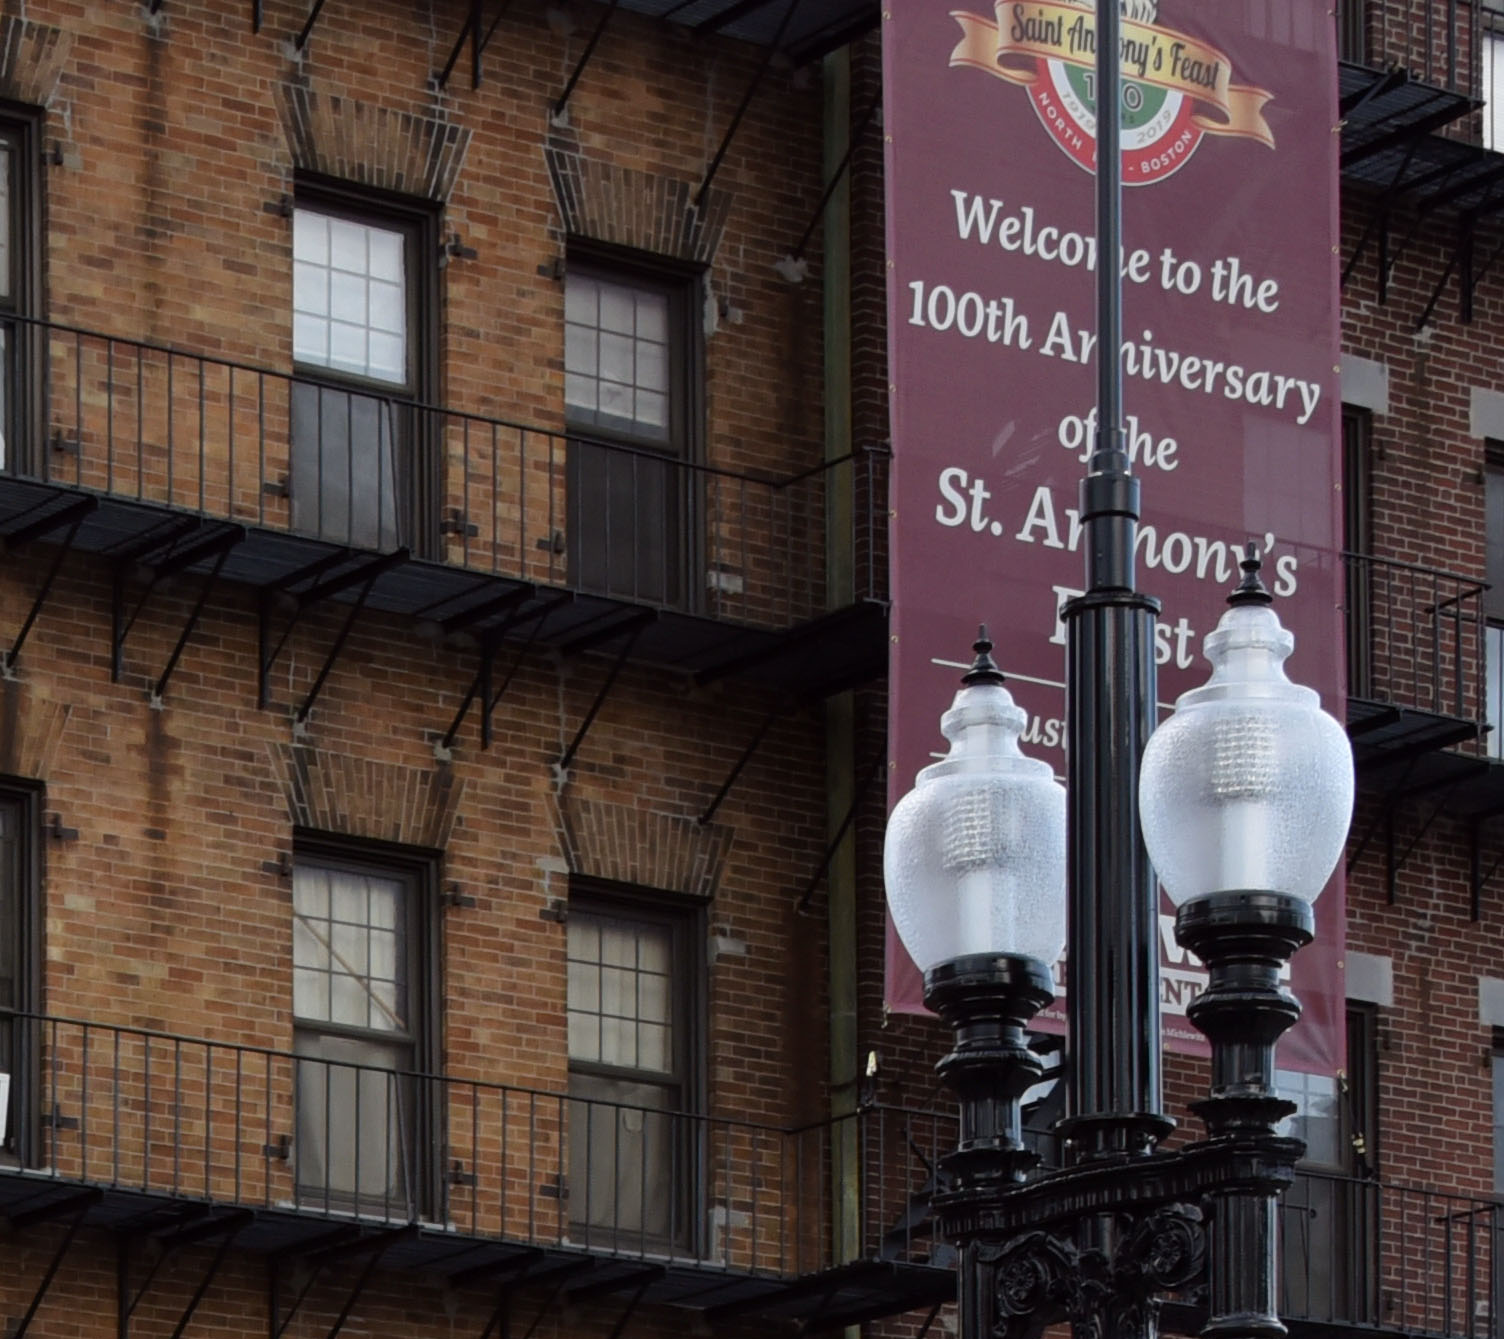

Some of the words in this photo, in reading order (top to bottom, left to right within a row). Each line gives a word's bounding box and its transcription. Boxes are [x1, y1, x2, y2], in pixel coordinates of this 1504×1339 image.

[1011, 4, 1063, 46] Saint
[1068, 19, 1162, 78] Anony's
[1170, 42, 1221, 91] Feast
[1084, 73, 1144, 112] 10
[1137, 108, 1173, 145] 2019
[1039, 91, 1084, 151] NORTH
[1141, 129, 1193, 174] BOSTON
[1161, 246, 1202, 295] to
[1211, 257, 1280, 313] the
[908, 280, 1029, 351] 100th
[1058, 407, 1101, 464] of
[1119, 415, 1179, 472] he
[935, 467, 1004, 538] St.
[1016, 485, 1298, 598] Aony's
[1049, 585, 1195, 670] Fst
